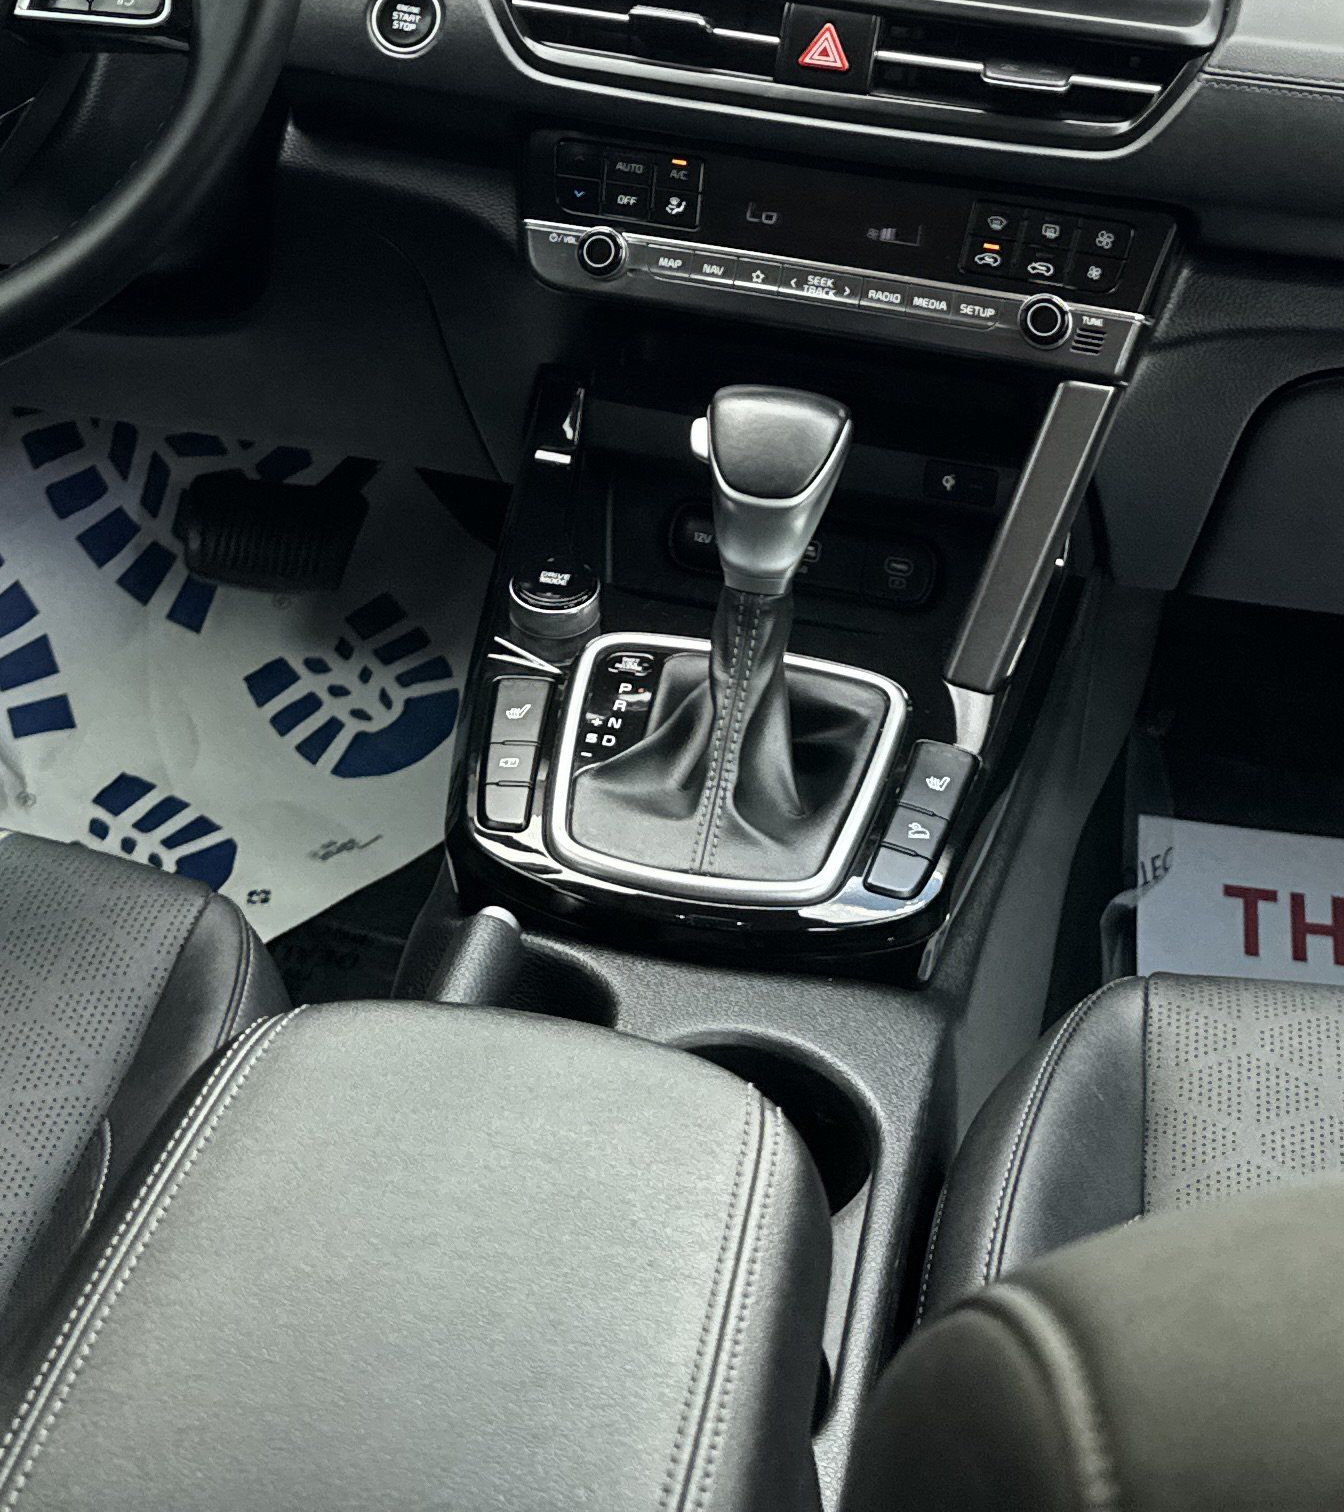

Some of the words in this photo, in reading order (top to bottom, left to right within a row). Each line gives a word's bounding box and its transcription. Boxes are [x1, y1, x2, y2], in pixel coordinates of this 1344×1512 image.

[392, 11, 422, 24] START
[391, 20, 417, 32] STOP
[615, 161, 644, 174] AUTO
[669, 169, 688, 181] A/C
[616, 194, 638, 206] OFF
[658, 257, 683, 269] MAP
[702, 263, 725, 276] NAV
[807, 275, 835, 288] SEEK
[802, 284, 837, 298] TRACK
[868, 289, 901, 304] RADIO
[912, 296, 948, 311] MEDIA
[959, 303, 996, 318] SETUP
[1082, 315, 1104, 327] TUNE
[618, 682, 633, 694] P
[612, 699, 627, 712] R
[607, 717, 622, 729] N
[601, 735, 616, 747] D
